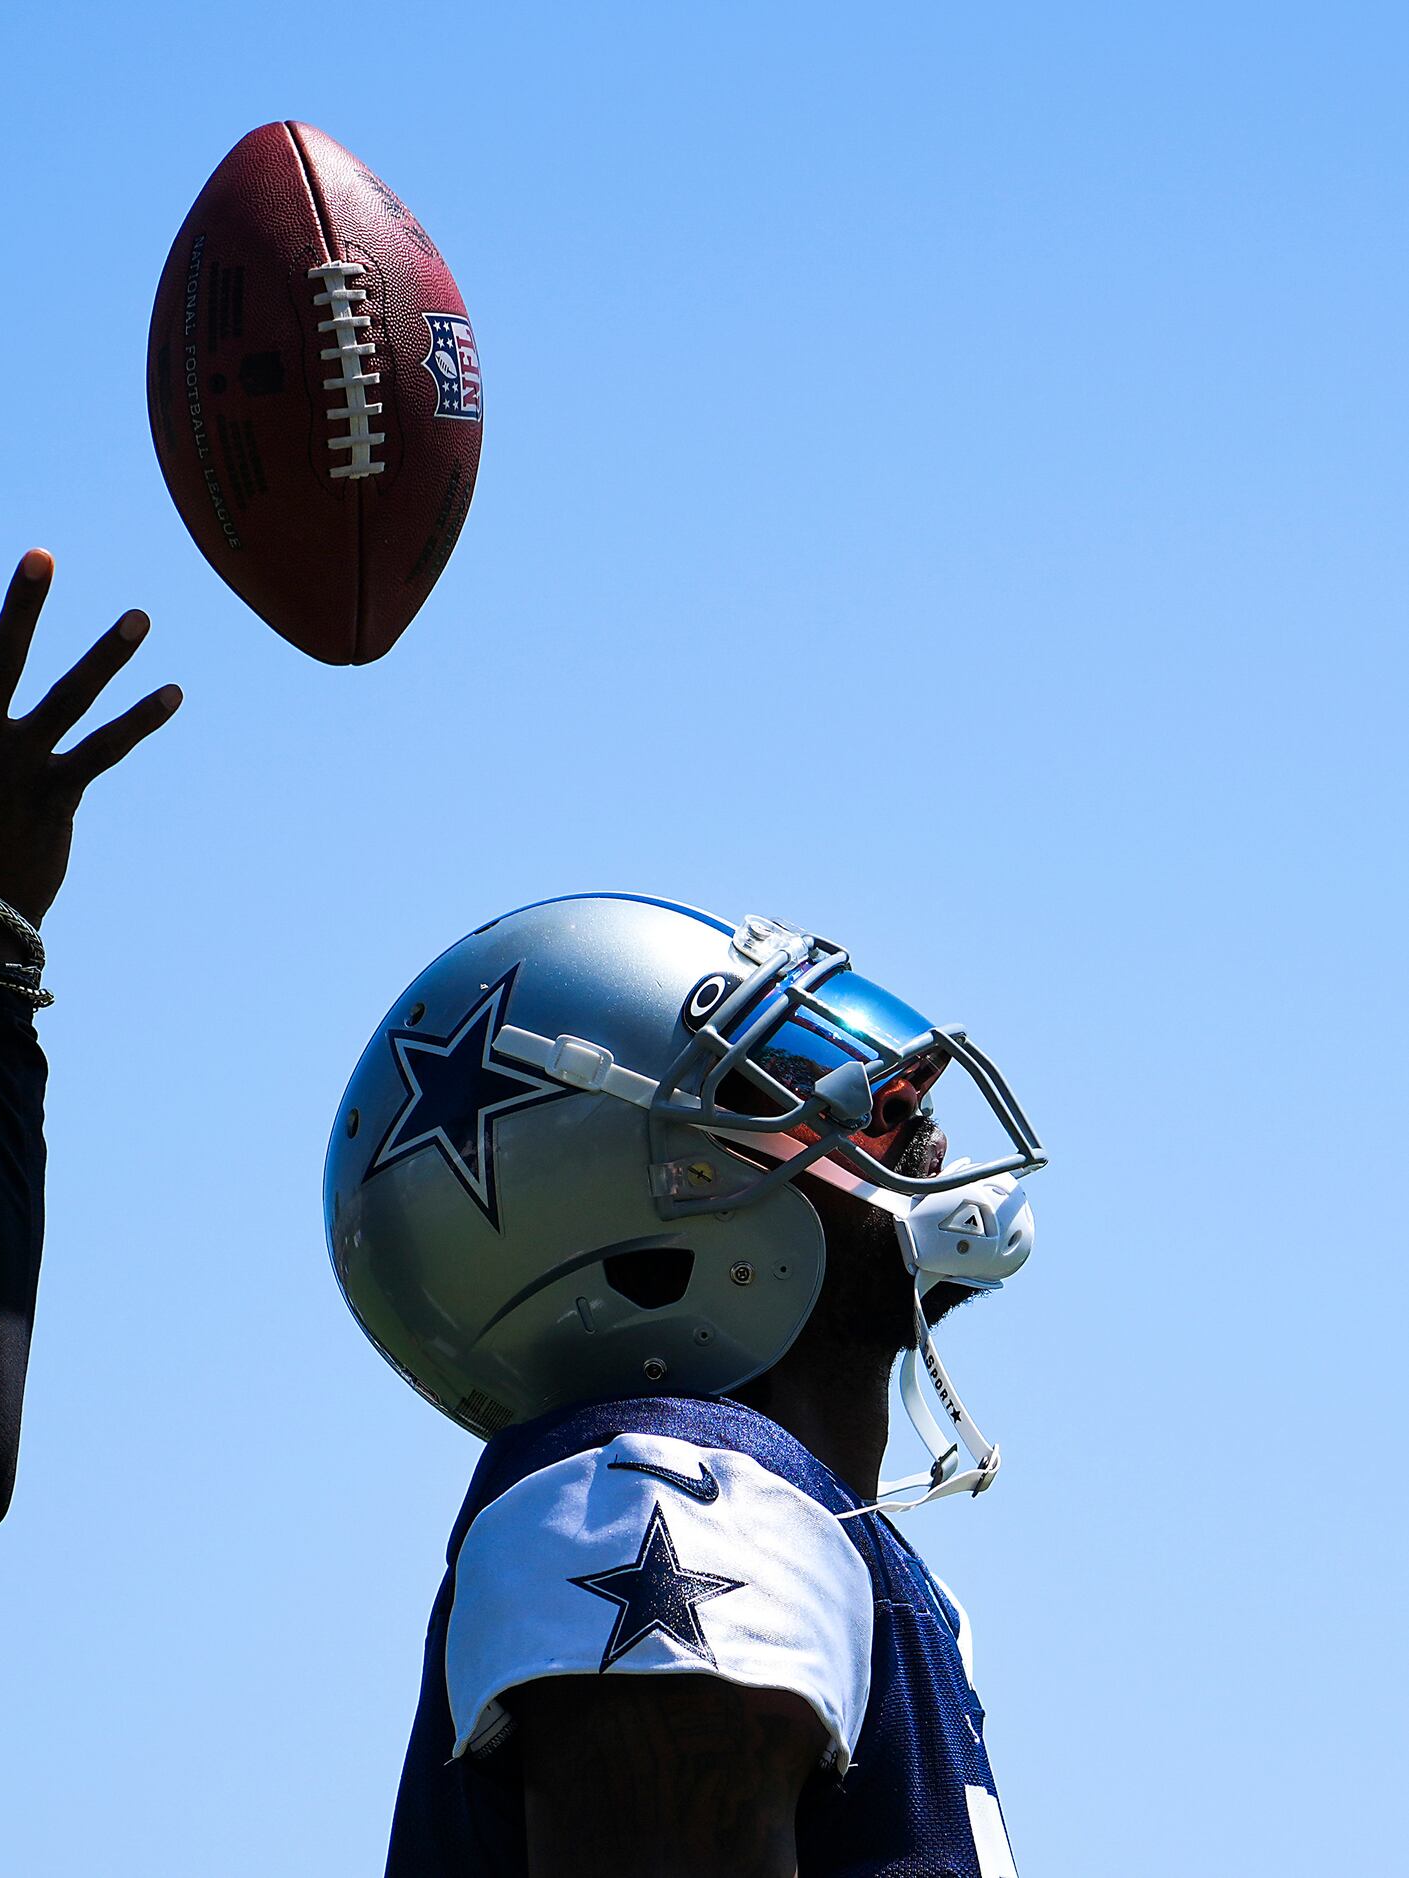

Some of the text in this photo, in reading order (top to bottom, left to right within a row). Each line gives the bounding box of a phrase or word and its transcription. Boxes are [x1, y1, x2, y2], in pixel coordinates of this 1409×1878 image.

[184, 235, 241, 550] NATIONAL FOOTBALL LEAGUE
[456, 328, 480, 408] NFL
